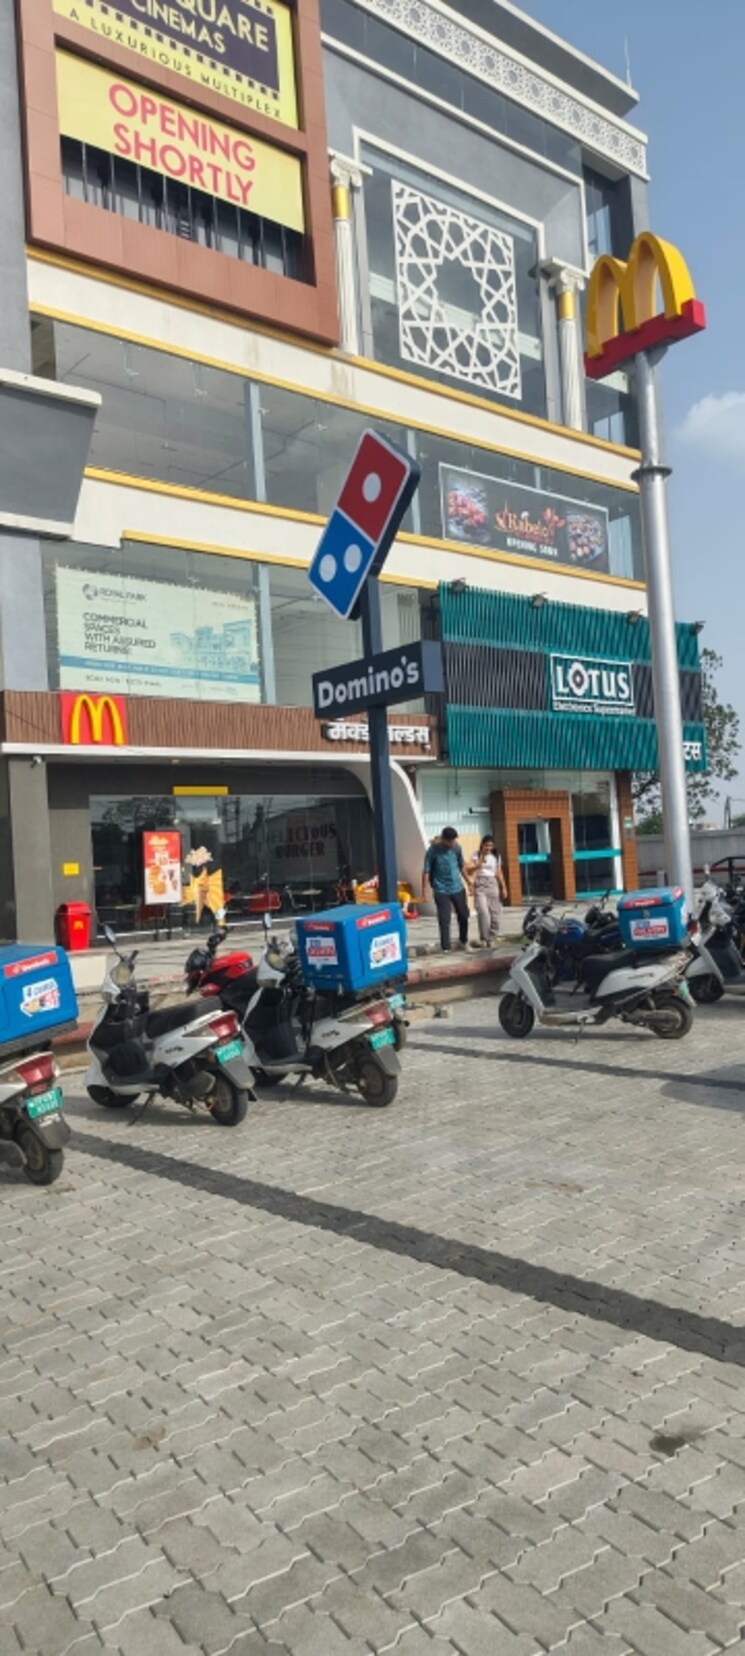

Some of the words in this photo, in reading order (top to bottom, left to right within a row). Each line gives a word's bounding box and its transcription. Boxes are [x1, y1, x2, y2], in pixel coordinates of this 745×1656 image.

[131, 0, 226, 54] CINEMAS
[69, 8, 81, 22] A
[90, 19, 192, 75] LUXURIOUS
[200, 74, 282, 119] MULTIPLEX
[109, 83, 256, 172] OPENING
[113, 123, 254, 207] SHORTLY
[83, 612, 148, 629] COMMERCIAL
[84, 623, 121, 635] SPACES
[84, 632, 110, 643] WITH
[112, 636, 156, 648] ASSURED
[318, 655, 420, 709] Domino's
[556, 662, 630, 699] LOTUS
